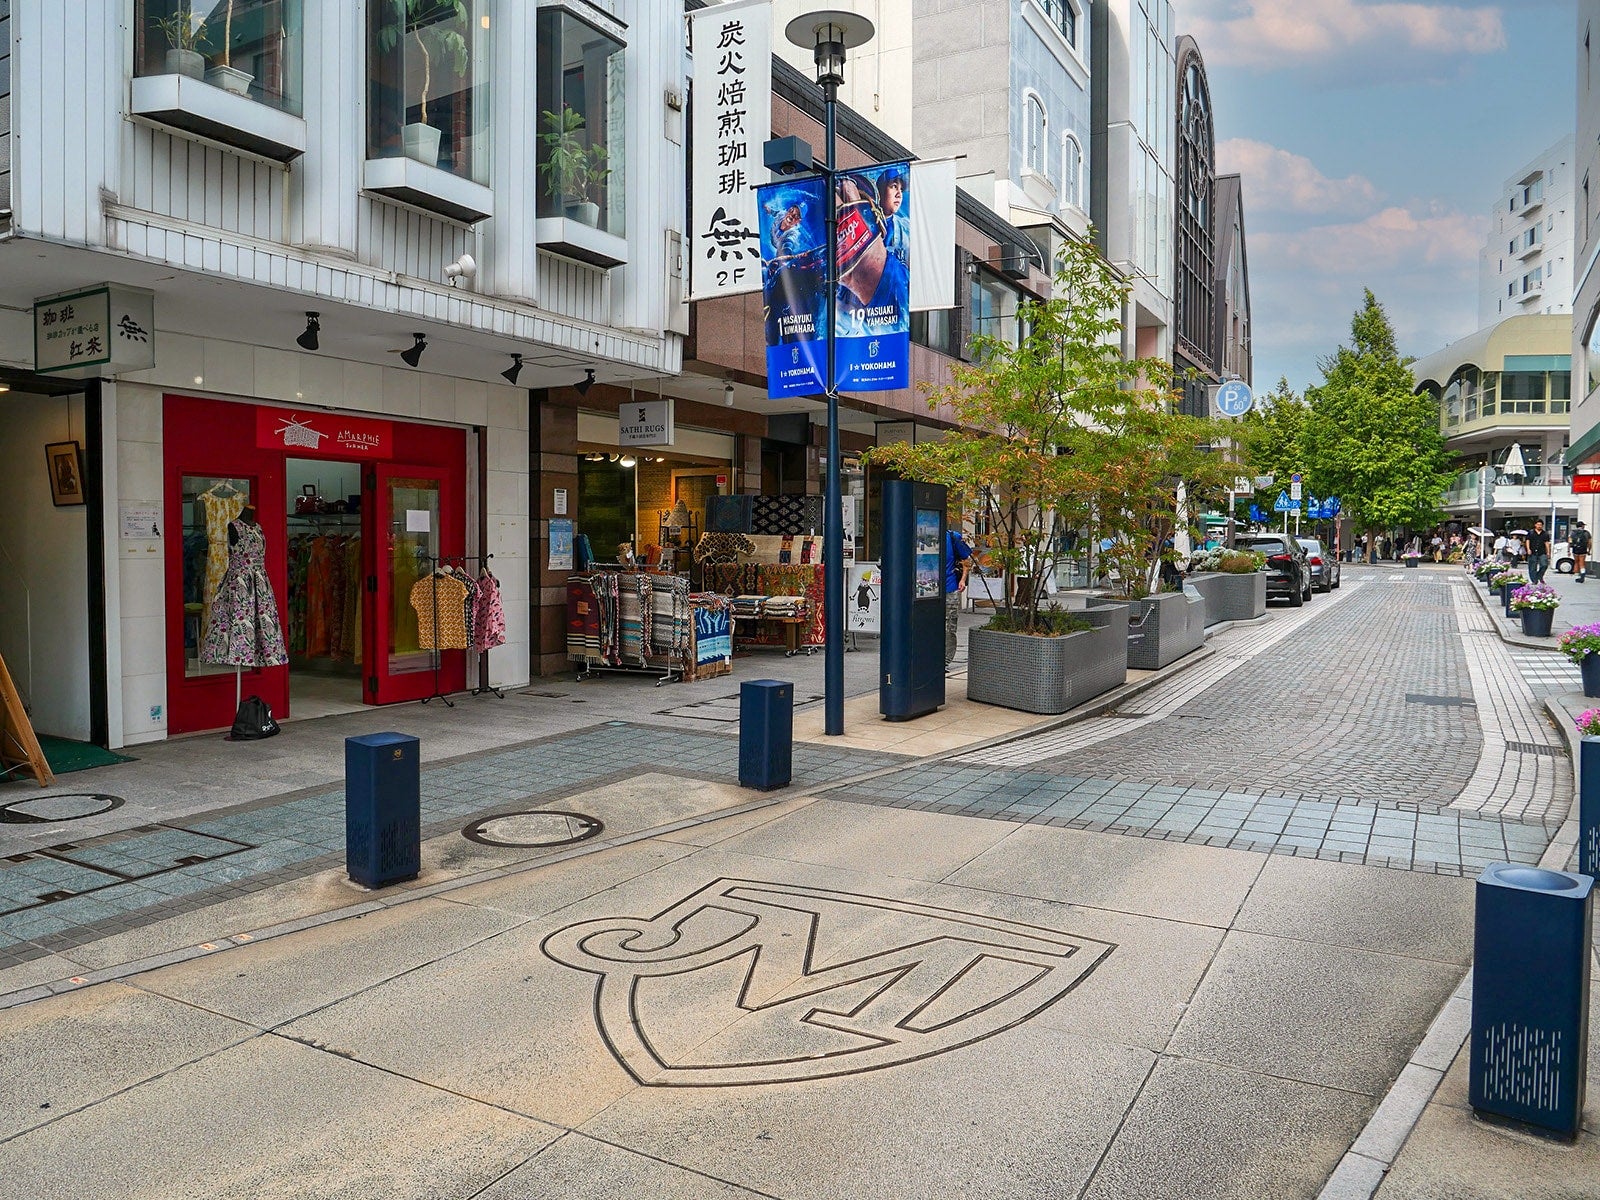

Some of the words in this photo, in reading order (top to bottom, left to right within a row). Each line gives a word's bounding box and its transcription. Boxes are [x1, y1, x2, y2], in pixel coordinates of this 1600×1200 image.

[717, 20, 747, 195] 炭火焙煎珈琲
[716, 268, 746, 287] 2F
[43, 304, 75, 326] 珈琲
[849, 308, 866, 328] 19
[866, 305, 894, 316] YASUAKI
[777, 317, 783, 337] 1
[866, 315, 898, 327] YAMASAKI
[70, 337, 103, 360] 紅茶
[788, 367, 815, 377] YOKOHAMA
[861, 361, 896, 371] YOKOHAMA
[1225, 390, 1239, 411] P
[621, 426, 642, 434] SATHI
